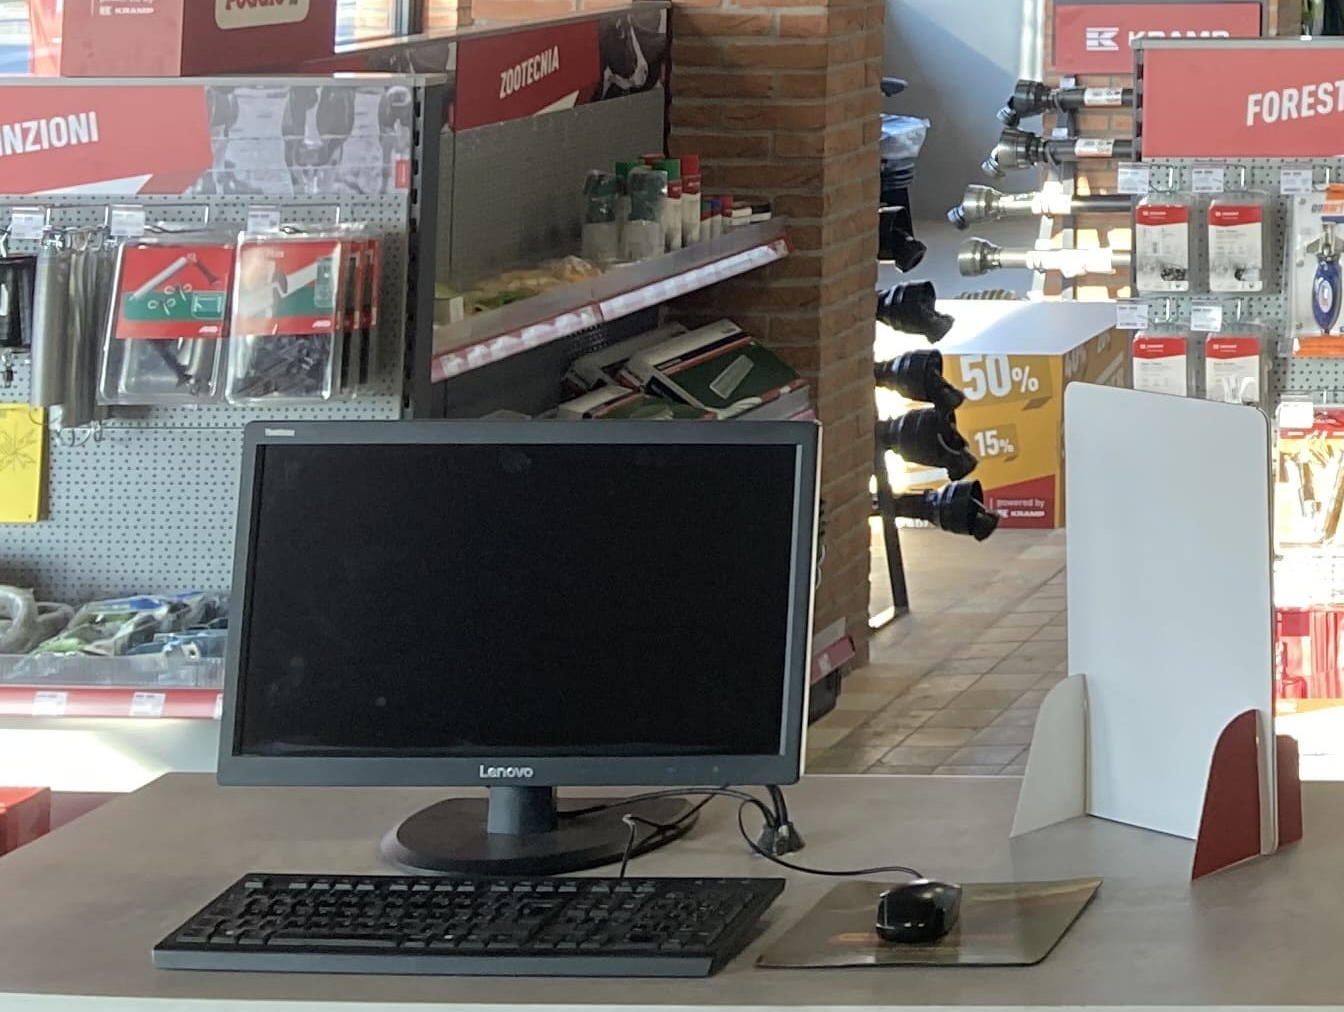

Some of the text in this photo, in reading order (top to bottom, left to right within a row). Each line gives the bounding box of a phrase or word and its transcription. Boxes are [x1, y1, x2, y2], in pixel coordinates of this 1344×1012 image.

[499, 45, 560, 101] ZOOTECNIA
[960, 355, 1039, 402] 50%
[974, 430, 1015, 457] 15%
[996, 497, 1046, 510] powered by
[1011, 510, 1045, 518] KRAMP
[479, 764, 534, 778] Lenovo
